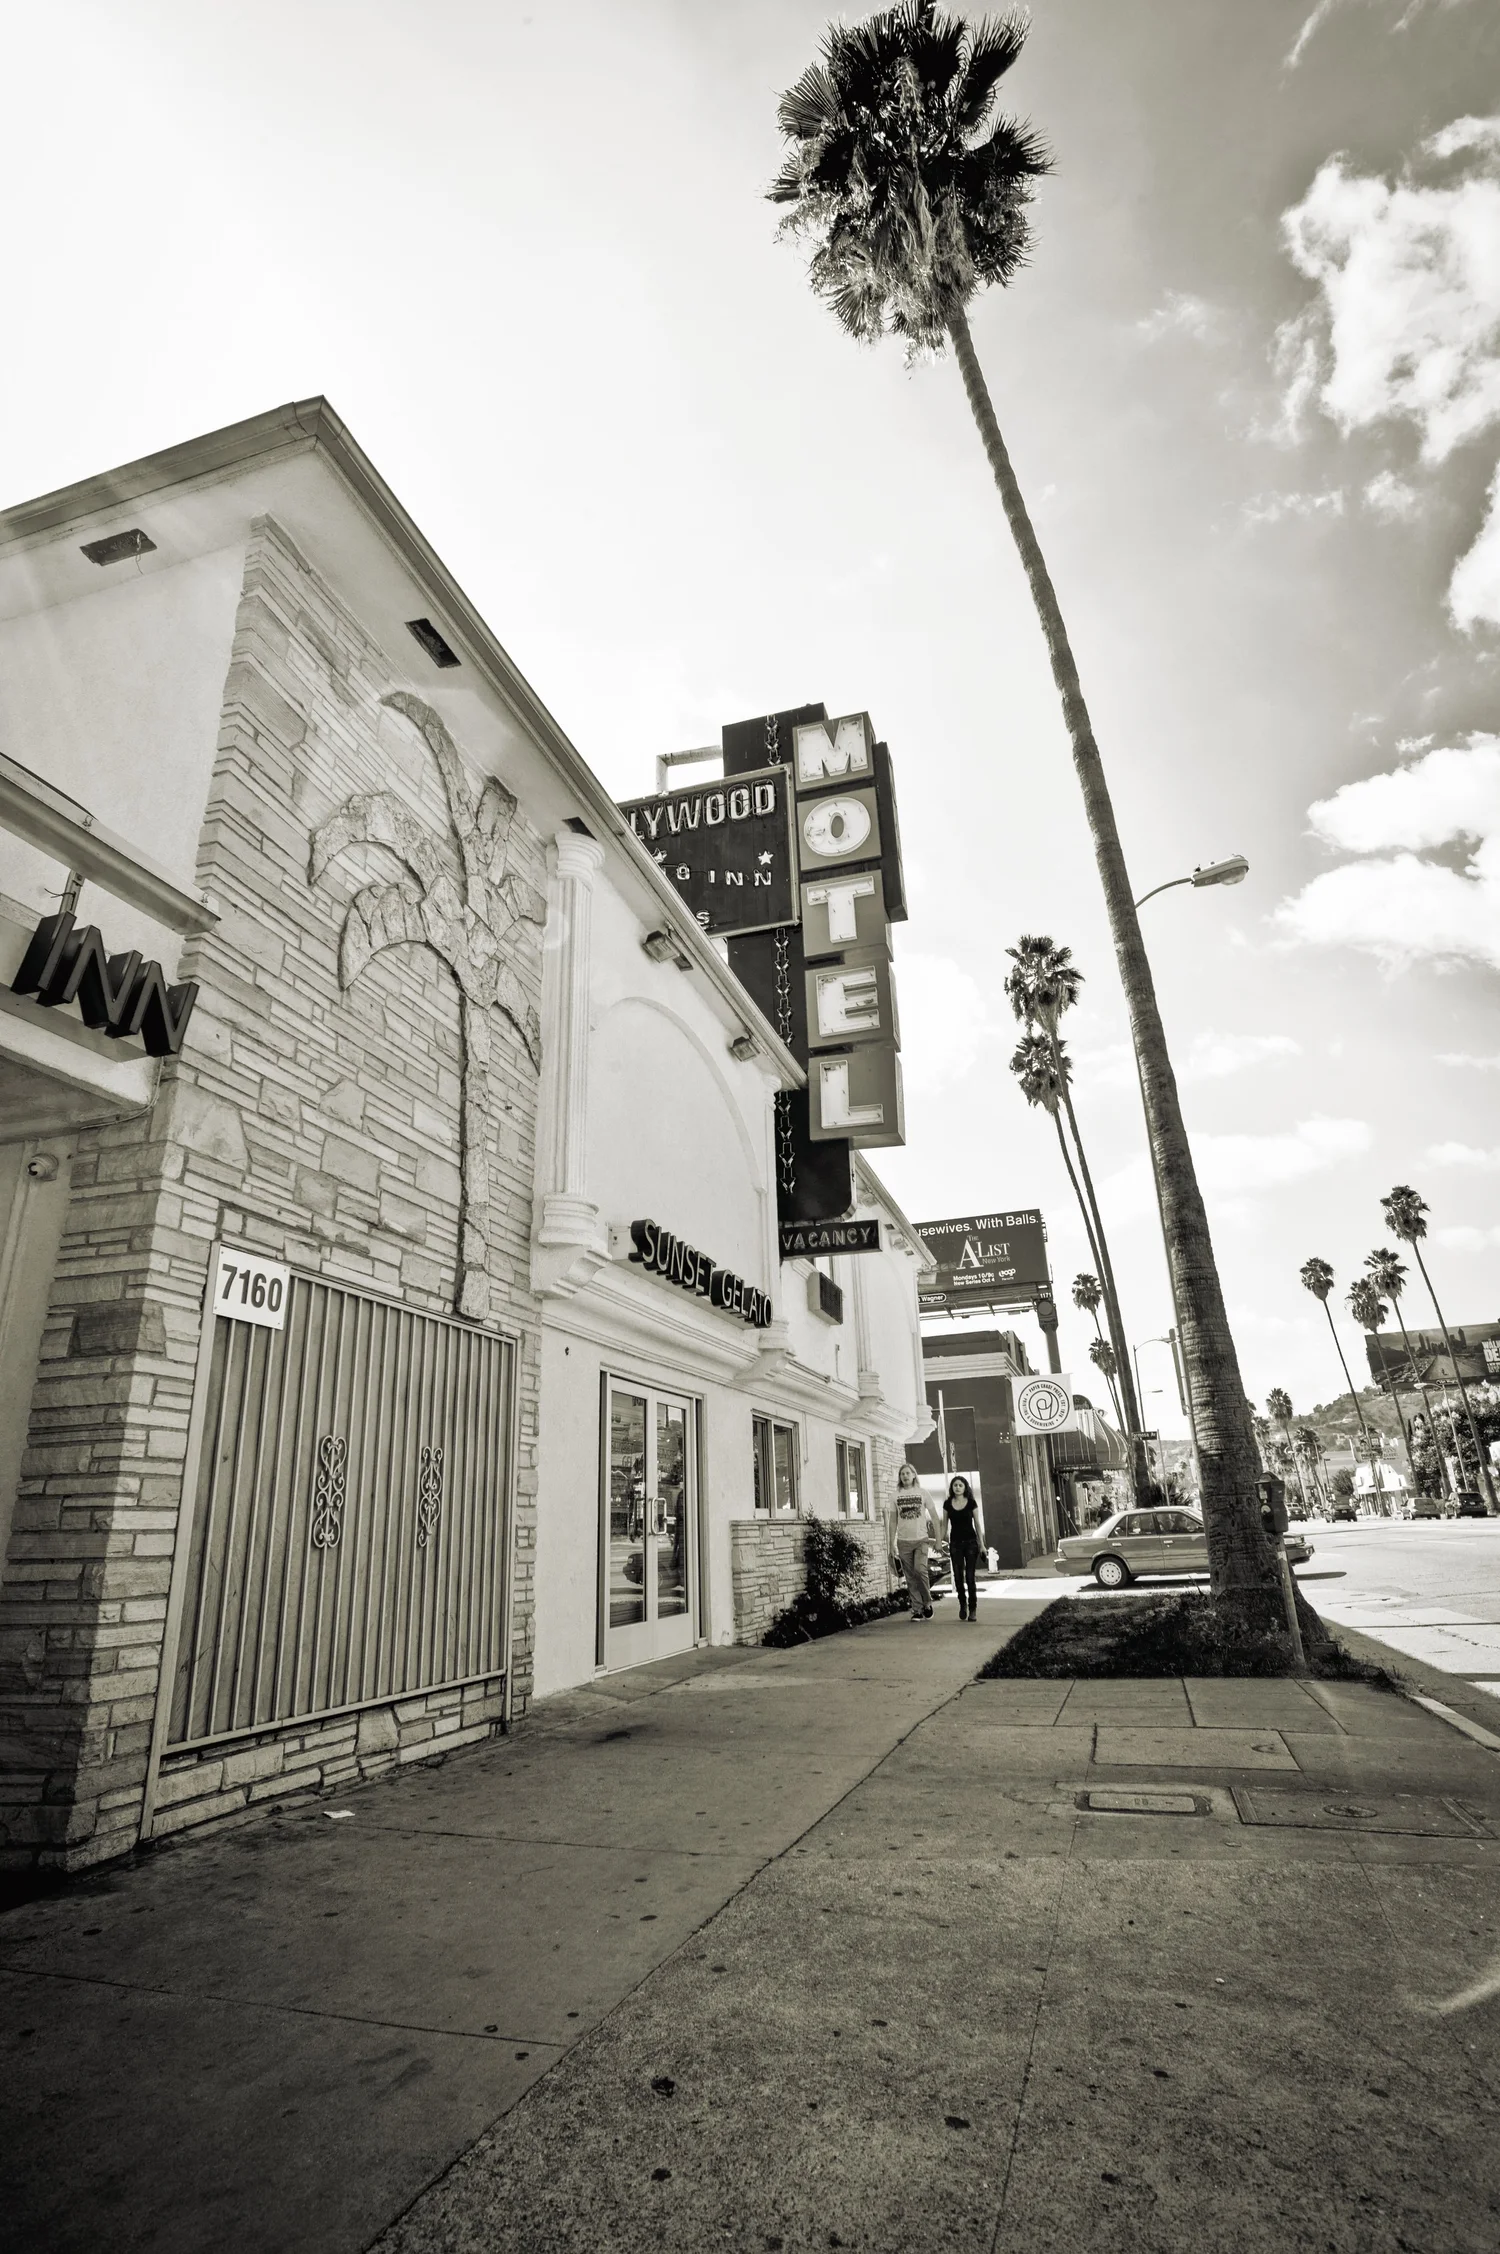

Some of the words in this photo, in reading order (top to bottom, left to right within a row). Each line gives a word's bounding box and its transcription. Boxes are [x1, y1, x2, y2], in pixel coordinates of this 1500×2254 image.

[707, 868, 772, 887] INN
[796, 714, 884, 1129] MOTEL
[11, 911, 199, 1057] INN
[976, 1217, 1003, 1230] With
[1005, 1213, 1039, 1227] Balls.
[781, 1226, 871, 1251] VACANCY
[982, 1257, 997, 1265] New
[997, 1255, 1011, 1263] York
[631, 1219, 717, 1296] SUNSET
[712, 1269, 773, 1328] GELATO
[220, 1264, 284, 1312] 7160
[921, 1294, 944, 1303] Wagner
